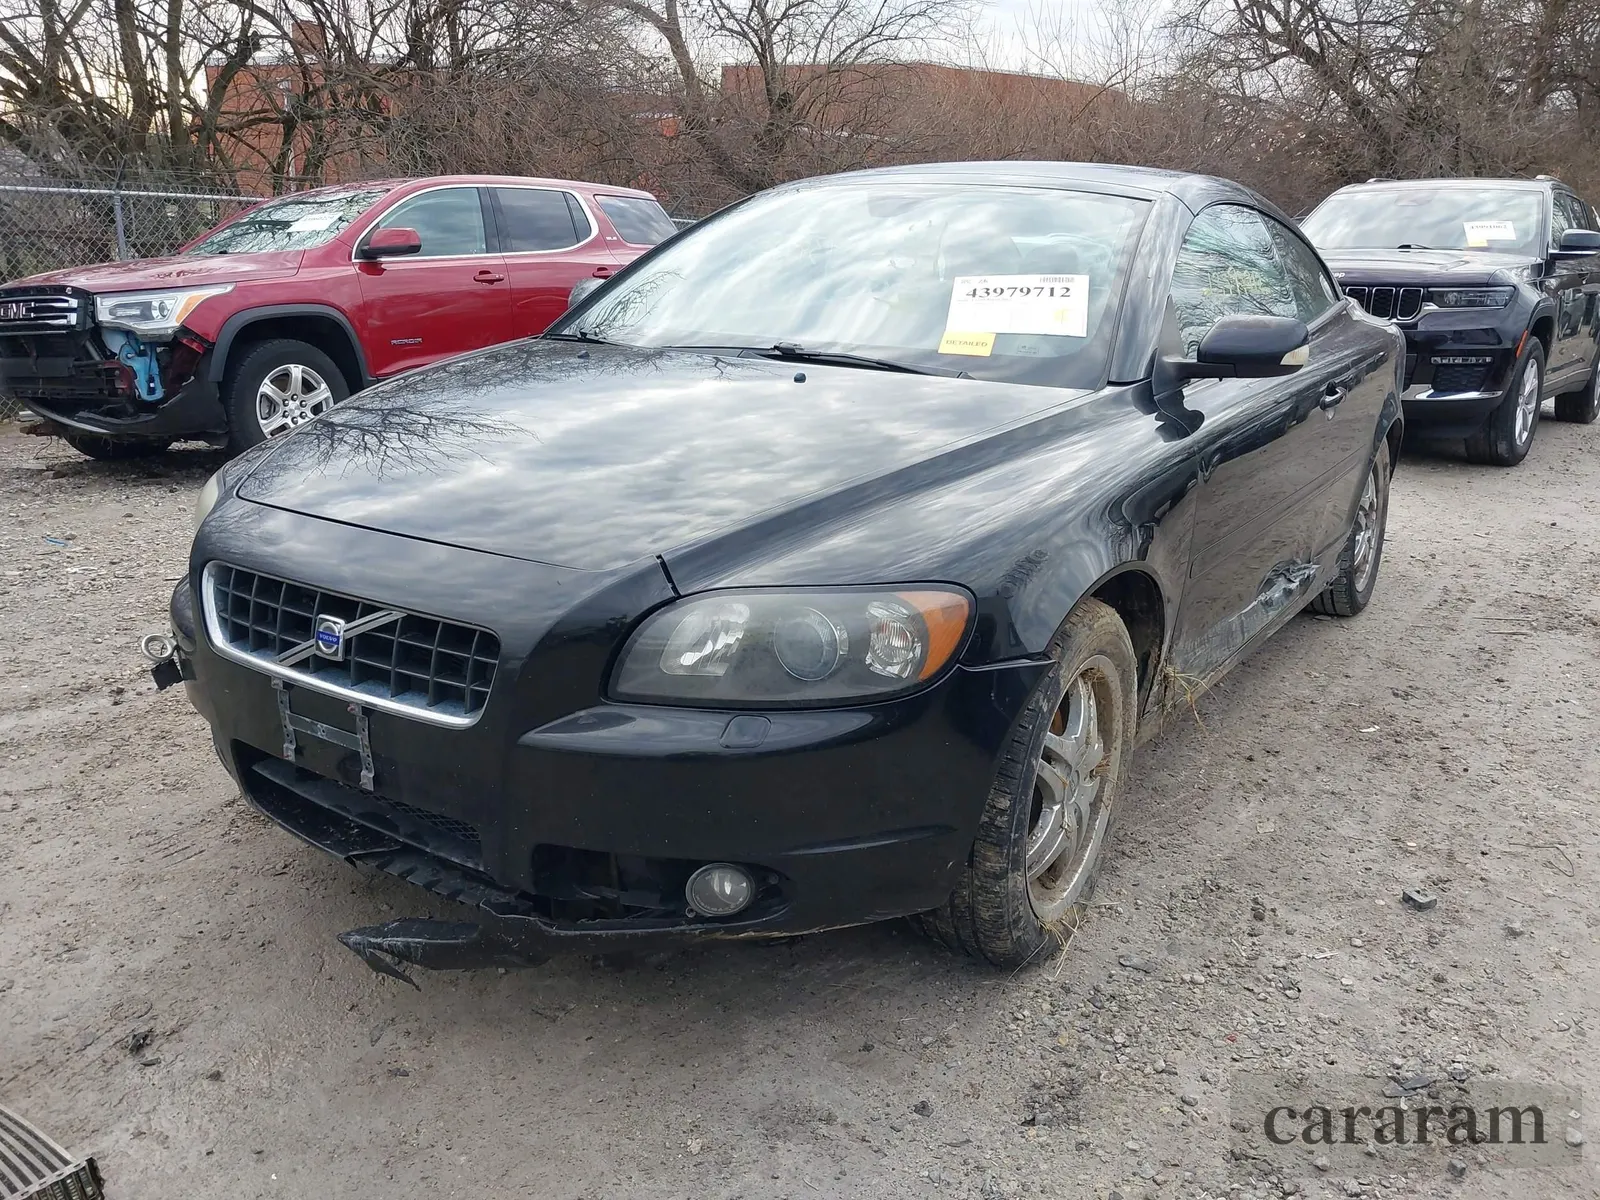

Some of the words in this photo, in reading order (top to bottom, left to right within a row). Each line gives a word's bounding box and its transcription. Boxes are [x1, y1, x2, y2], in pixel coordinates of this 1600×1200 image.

[965, 286, 1072, 299] 43979712
[0, 301, 35, 320] GMC
[945, 339, 989, 348] DETAILED
[319, 633, 338, 643] VOLVO
